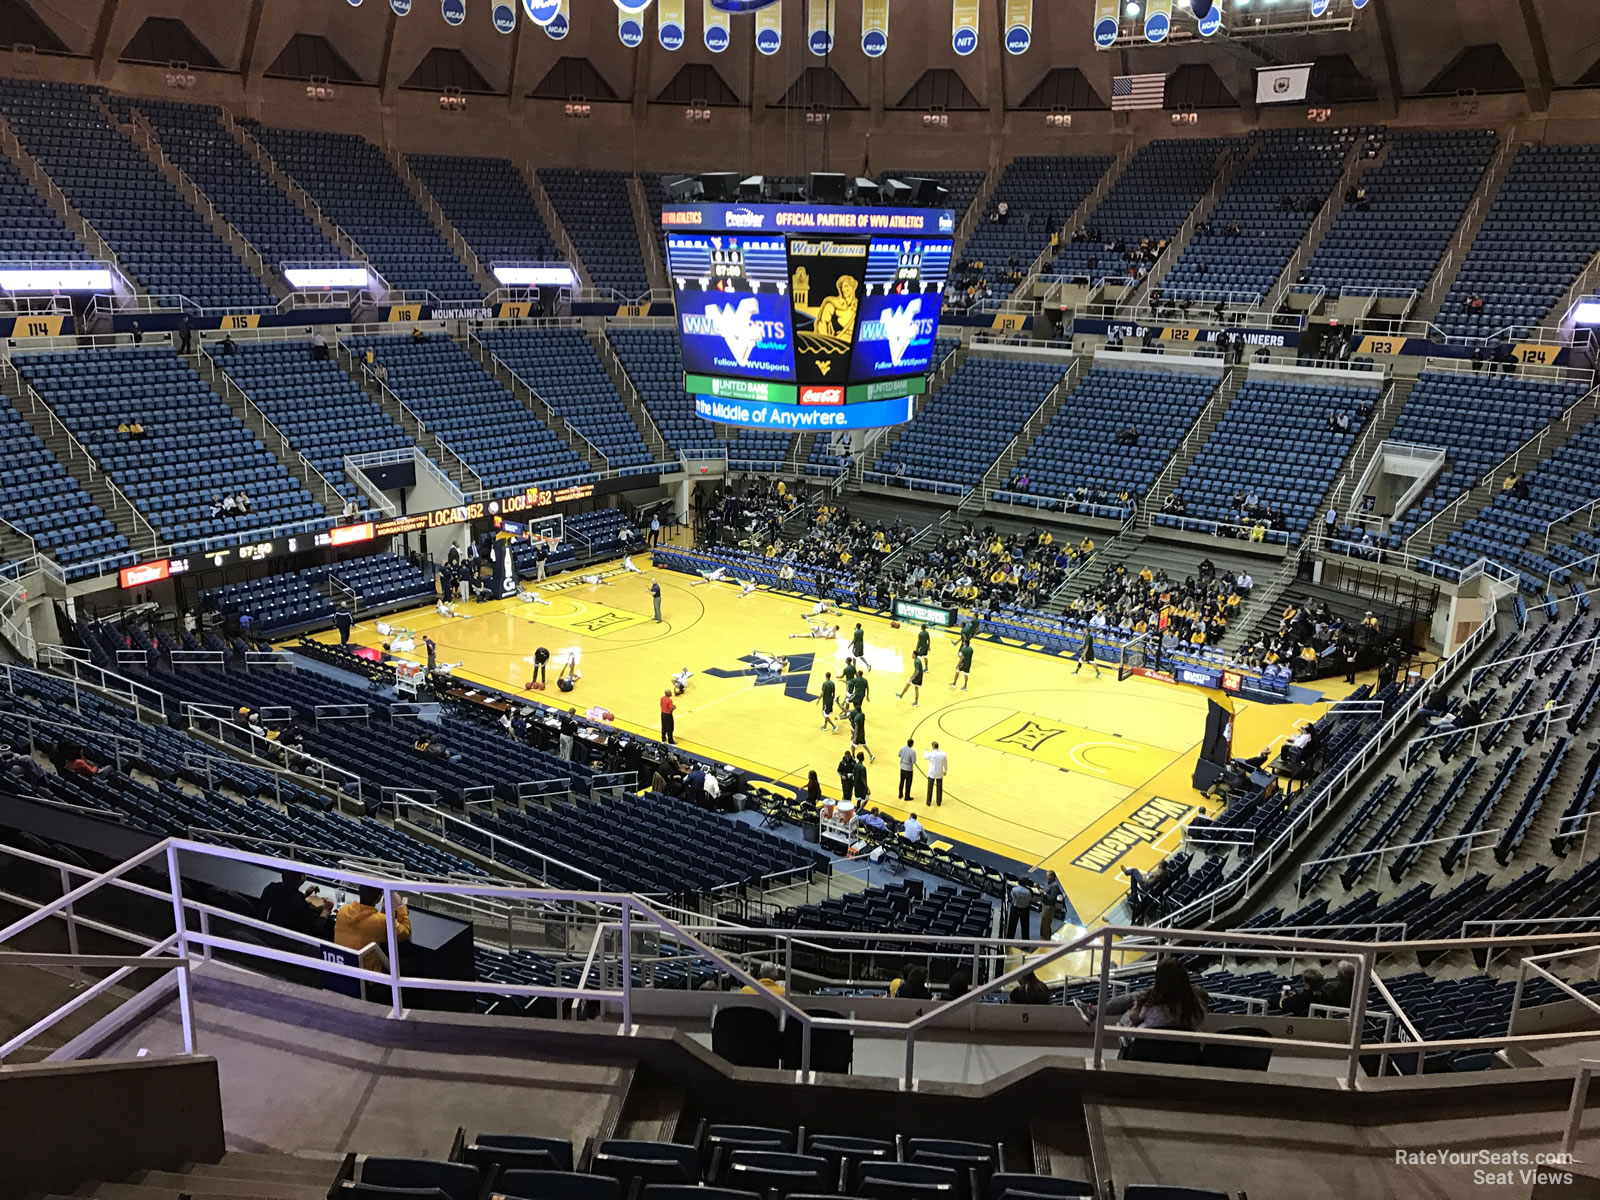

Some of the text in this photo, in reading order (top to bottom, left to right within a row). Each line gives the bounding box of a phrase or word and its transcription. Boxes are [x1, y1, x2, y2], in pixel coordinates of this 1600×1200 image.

[1147, 27, 1168, 36] NCAA
[663, 36, 682, 44] NCAA
[709, 39, 727, 47] NCAA
[957, 37, 974, 47] NIT
[1098, 33, 1117, 42] NCAA
[760, 41, 779, 49] NCAA
[1009, 41, 1029, 49] NCAA
[776, 212, 815, 226] OFFICIAL
[817, 213, 857, 227] PARTNER
[858, 214, 869, 227] OF
[870, 215, 888, 228] WVU
[889, 215, 924, 229] ATHLETICS
[399, 311, 411, 322] 116
[509, 307, 520, 318] 117
[628, 307, 640, 317] 118
[232, 316, 248, 328] 115
[1003, 319, 1015, 330] 121
[29, 323, 48, 335] 114
[1171, 329, 1189, 341] 122
[1370, 341, 1392, 354] 123
[714, 357, 738, 367] Follow
[1522, 350, 1546, 364] 124
[720, 380, 769, 394] UNITED BANK
[873, 379, 908, 393] UNITED BANK
[701, 400, 711, 412] the
[713, 402, 749, 422] Middle
[752, 407, 767, 422] of
[770, 407, 848, 428] Anywhere.
[1022, 1013, 1029, 1023] 5
[1287, 1026, 1294, 1035] 8
